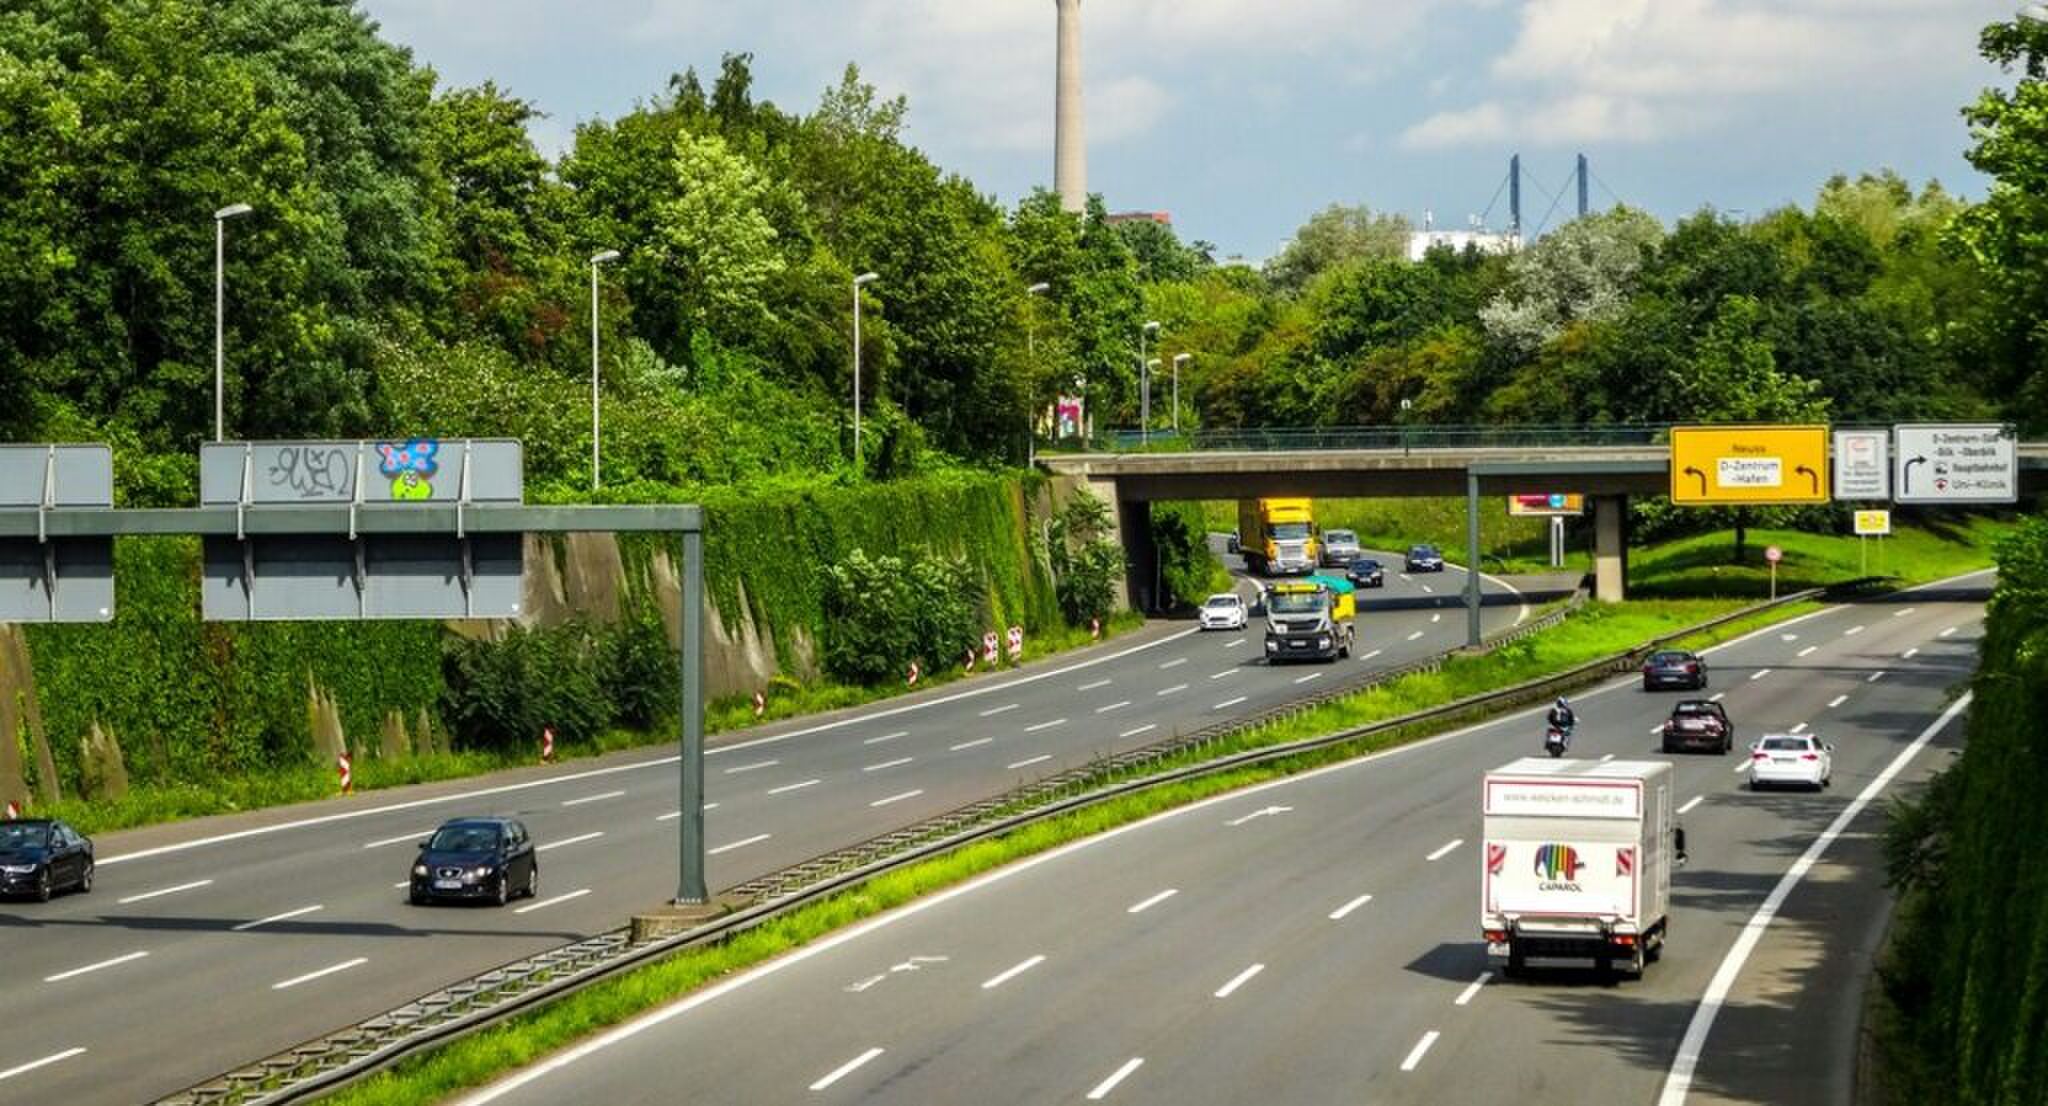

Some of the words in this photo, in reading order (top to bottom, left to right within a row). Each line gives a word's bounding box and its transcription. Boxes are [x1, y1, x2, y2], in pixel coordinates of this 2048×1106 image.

[1720, 460, 1778, 471] D-Zentrum
[1731, 473, 1768, 483] -Hafen
[1538, 882, 1583, 893] CAPAROL
